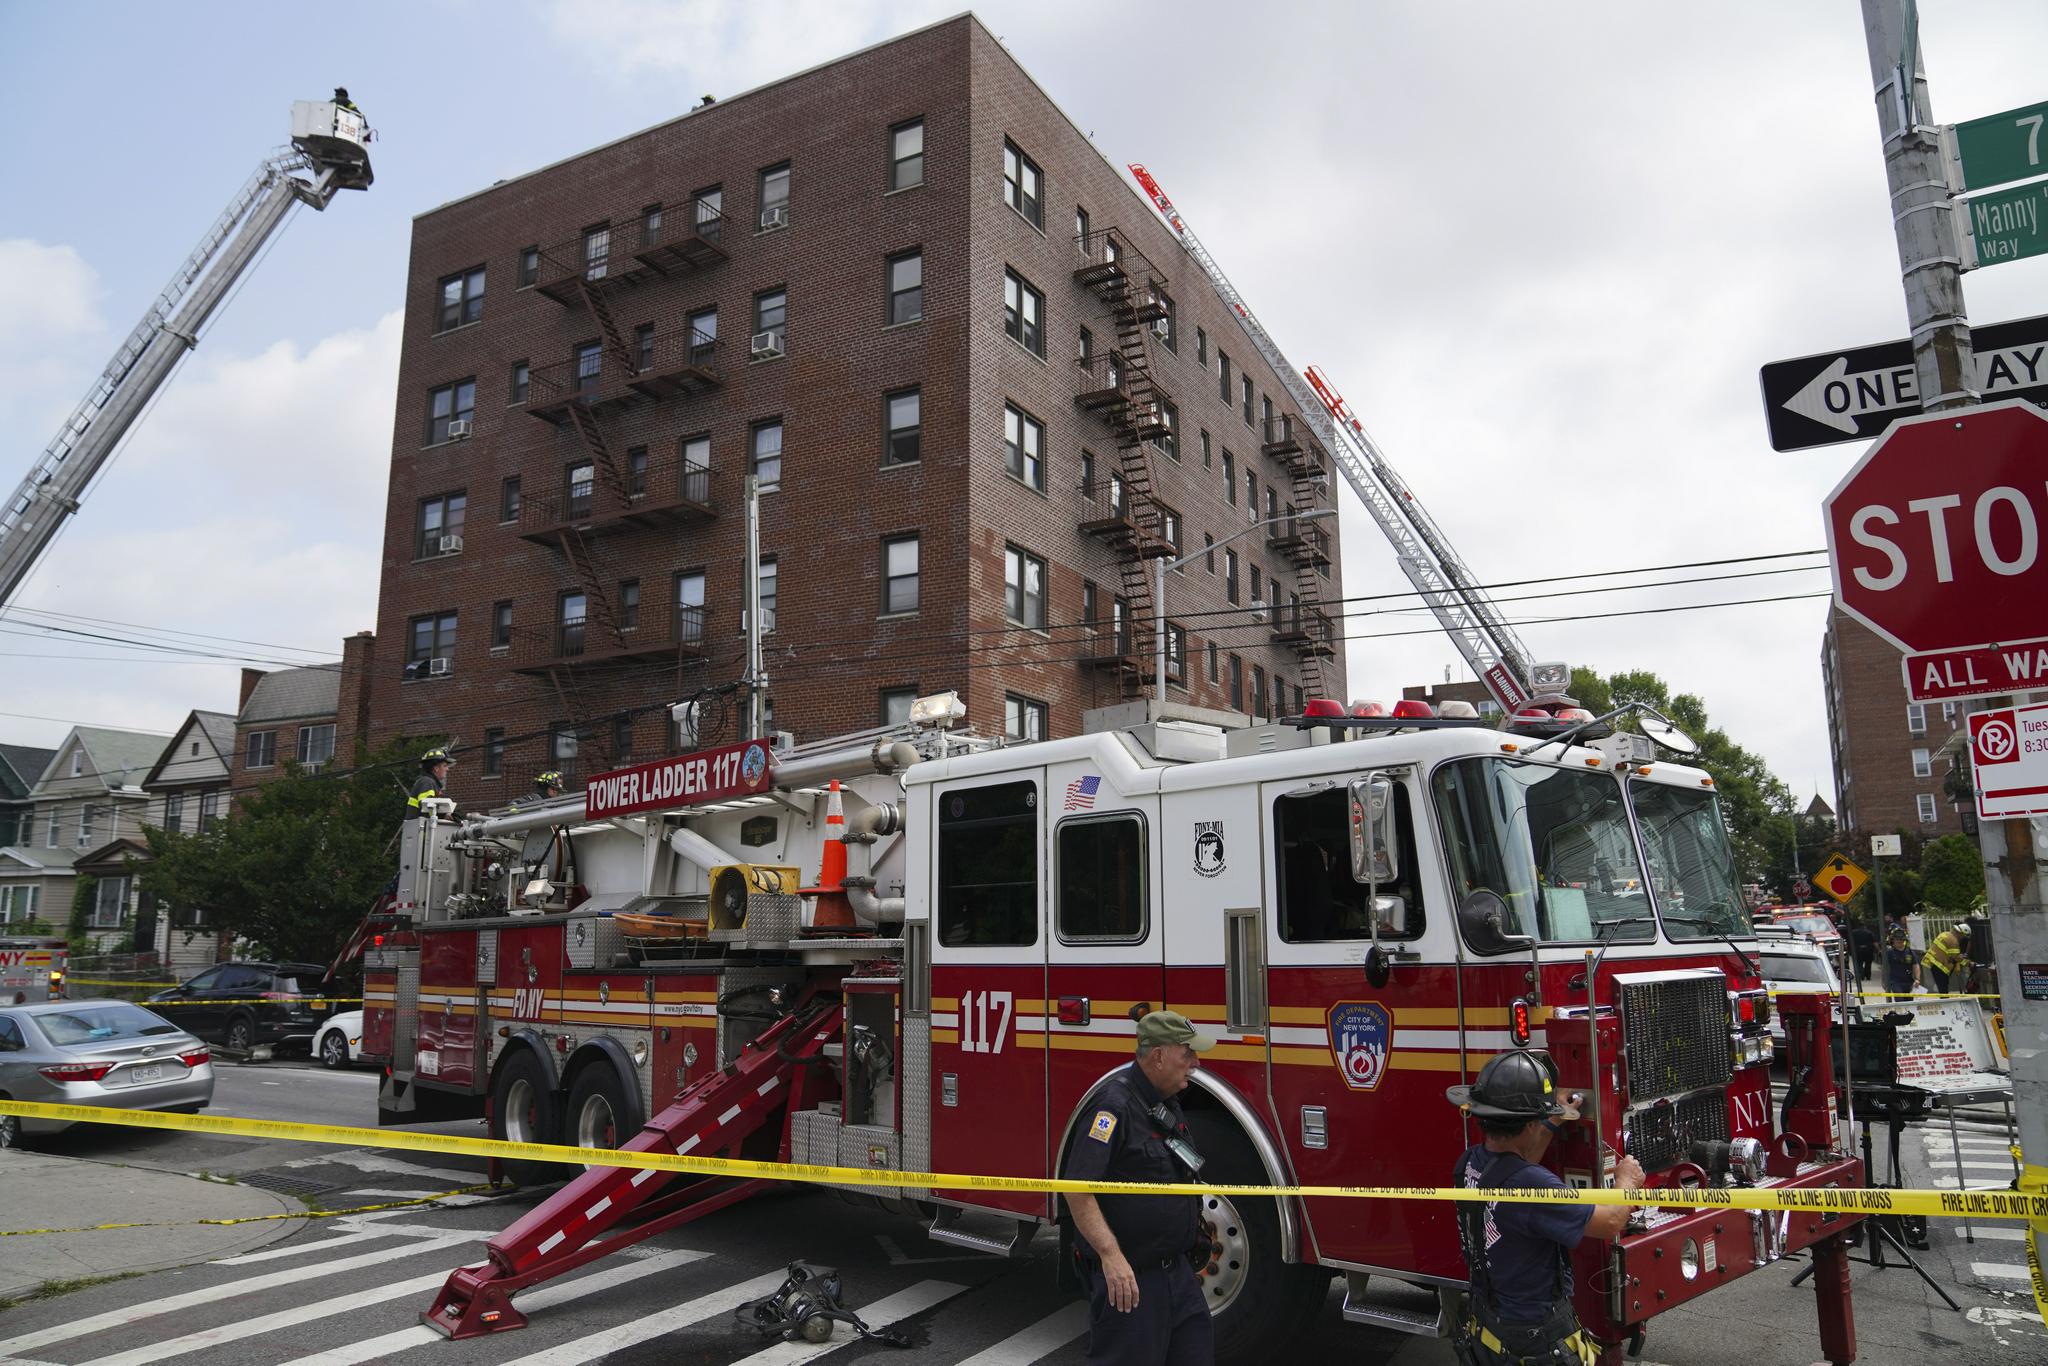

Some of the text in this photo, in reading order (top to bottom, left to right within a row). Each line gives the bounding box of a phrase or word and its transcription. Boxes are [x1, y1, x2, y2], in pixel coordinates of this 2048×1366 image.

[2015, 113, 2044, 166] 7
[1975, 196, 2037, 237] Manny
[1981, 237, 2018, 259] Way
[1823, 346, 2045, 414] ONE AY
[1849, 481, 2048, 592] STO
[1490, 669, 1521, 706] ELMHURST
[1923, 657, 1988, 691] ALL
[588, 751, 742, 812] TOWER LADDER 117
[961, 991, 1013, 1055] 117
[1336, 1006, 1384, 1026] FIRE DEPARTMENT
[1343, 1024, 1377, 1032] NEW YORK
[1478, 1188, 1498, 1197] FIRE
[1520, 1188, 1533, 1198] DO
[1533, 1188, 1551, 1199] NOT
[1552, 1188, 1580, 1199] CROSS
[1623, 1188, 1731, 1204] FIRE LINE: DO NOT CROSS
[1776, 1189, 1892, 1210] FIRE LINE: DO NOT CROSS
[1940, 1193, 1965, 1212] FIRE
[1965, 1193, 1991, 1213] LINE:
[1991, 1195, 2007, 1214] DO
[2008, 1195, 2029, 1215] NOT
